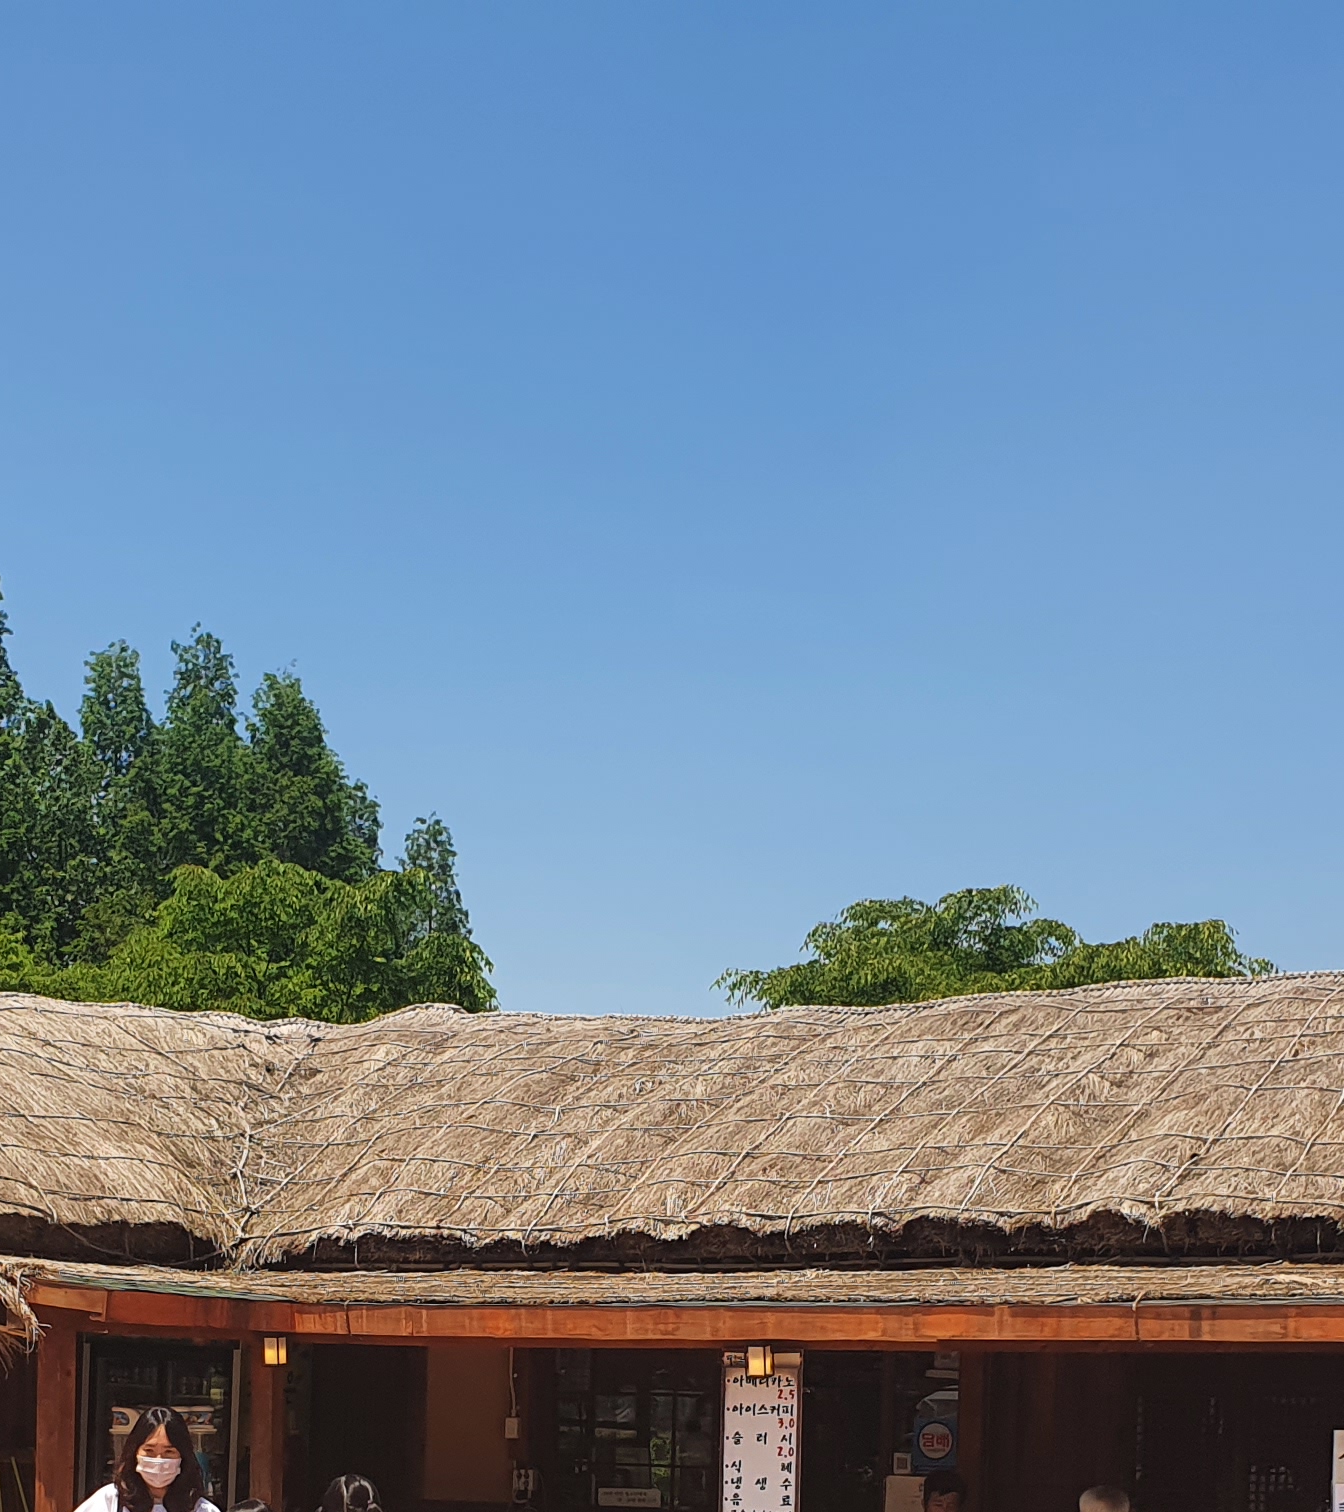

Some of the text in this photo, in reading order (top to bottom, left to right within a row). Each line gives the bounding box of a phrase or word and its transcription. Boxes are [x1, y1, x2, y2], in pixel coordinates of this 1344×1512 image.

[733, 1375, 795, 1388] 아메리카노
[777, 1389, 795, 1400] 2.5
[732, 1403, 794, 1417] 아이스커피
[778, 1418, 795, 1429] 3.0
[777, 1446, 795, 1458] 2.0
